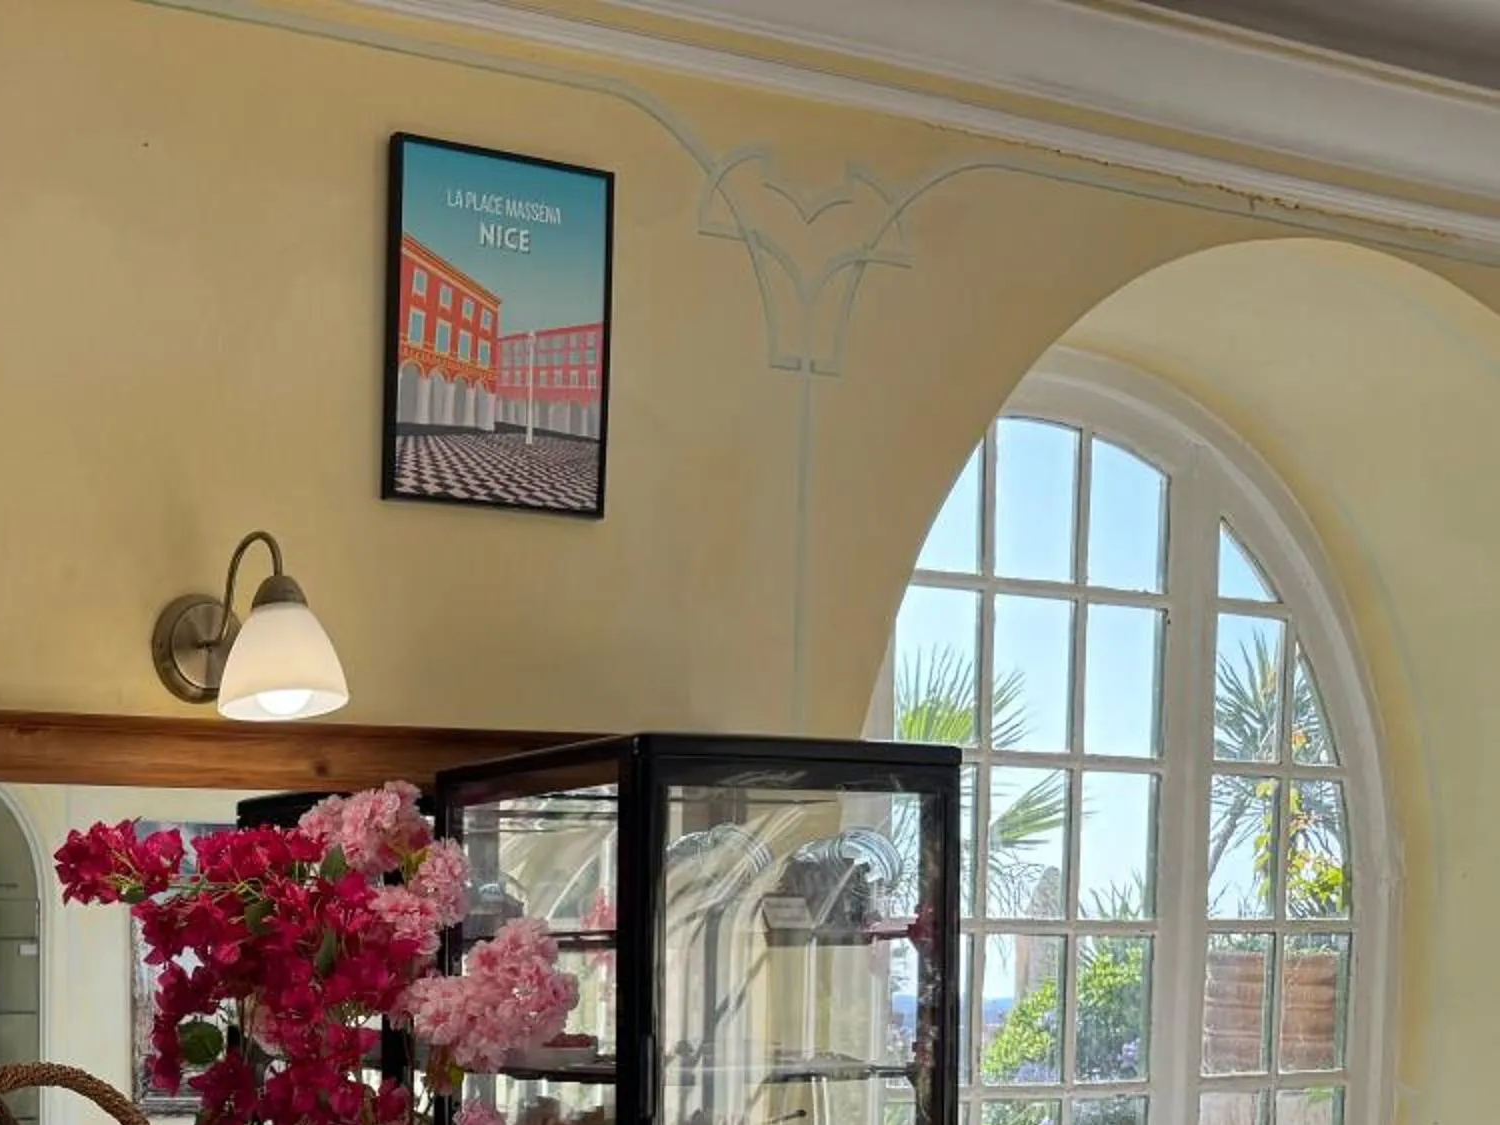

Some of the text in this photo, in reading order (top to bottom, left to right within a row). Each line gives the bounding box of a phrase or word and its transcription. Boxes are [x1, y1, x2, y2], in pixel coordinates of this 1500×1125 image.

[446, 188, 463, 209] LA
[465, 191, 503, 216] PLACE
[479, 222, 530, 253] NICE
